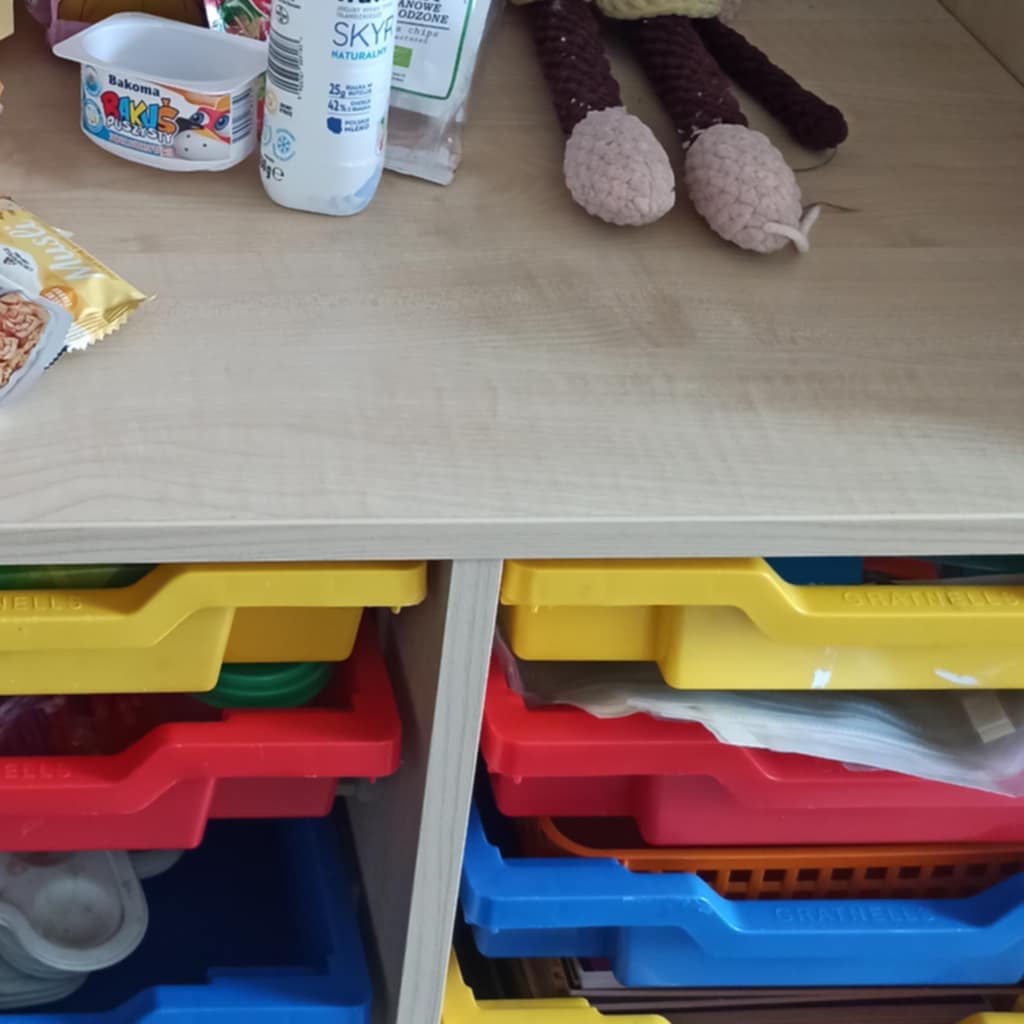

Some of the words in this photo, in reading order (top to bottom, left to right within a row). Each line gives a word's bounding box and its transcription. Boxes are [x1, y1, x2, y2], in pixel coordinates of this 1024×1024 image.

[398, 0, 442, 13] ANOWE
[398, 9, 449, 24] ODZONE
[108, 74, 160, 97] Bakoma
